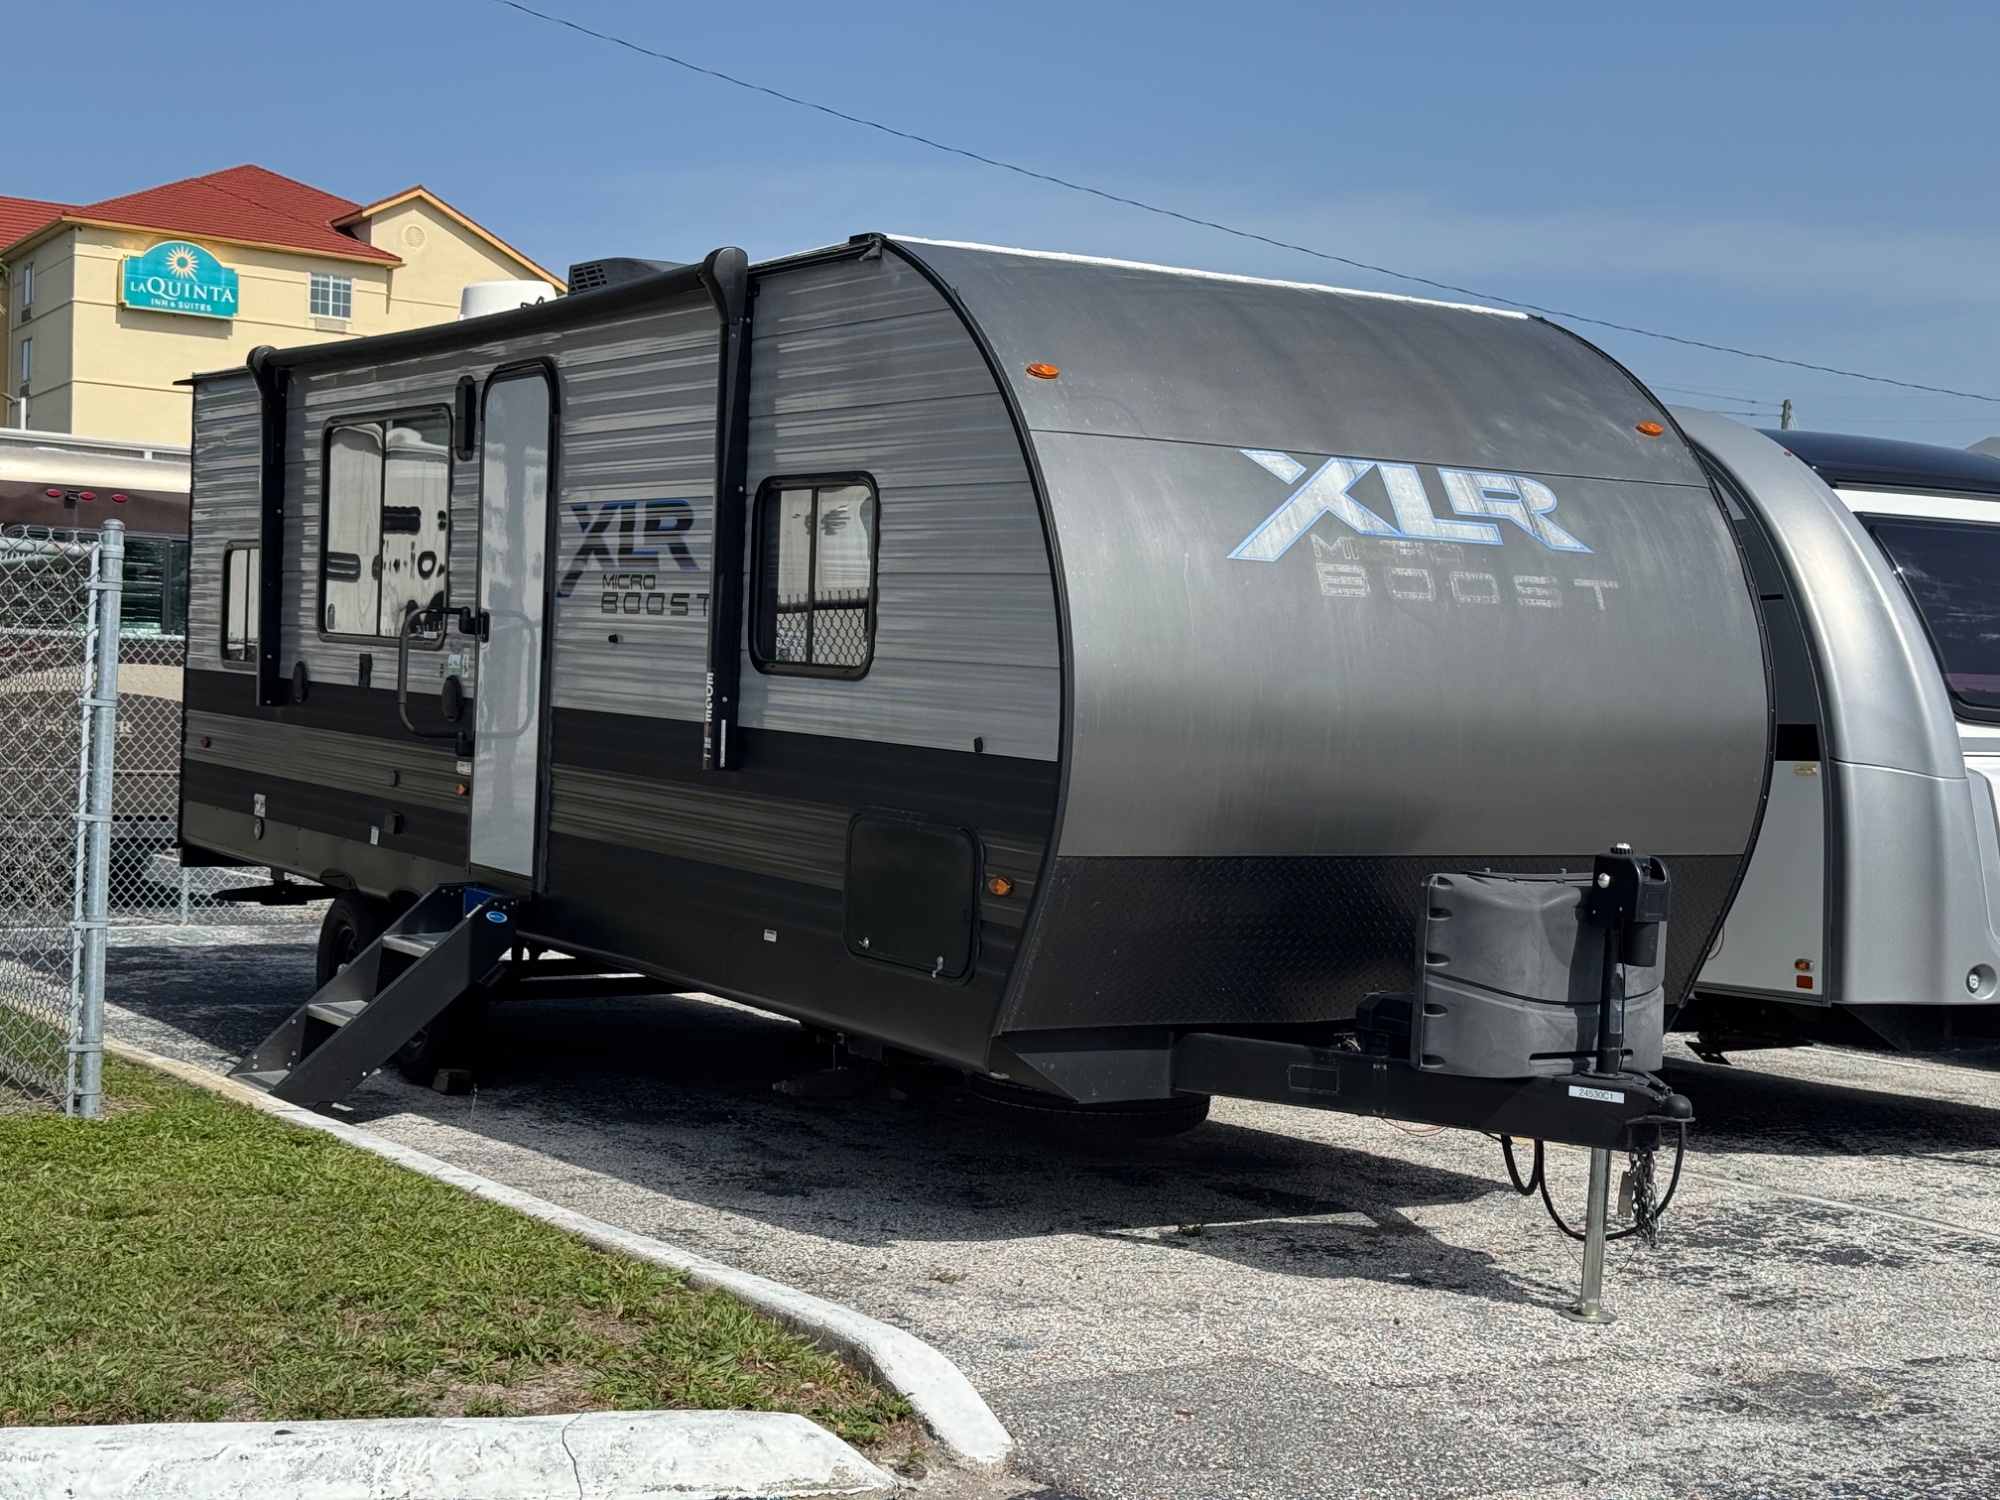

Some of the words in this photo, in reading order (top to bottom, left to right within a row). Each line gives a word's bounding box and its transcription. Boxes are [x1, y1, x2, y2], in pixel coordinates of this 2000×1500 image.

[151, 298, 168, 308] INN
[178, 301, 212, 312] SUITES
[1226, 449, 1594, 562] XLR
[556, 498, 700, 598] XLR
[1310, 534, 1464, 564] MIRO
[602, 573, 656, 590] MICRO
[1315, 562, 1620, 611] BOOST
[601, 591, 710, 617] BOOST
[1578, 1088, 1614, 1100] 24530C1
